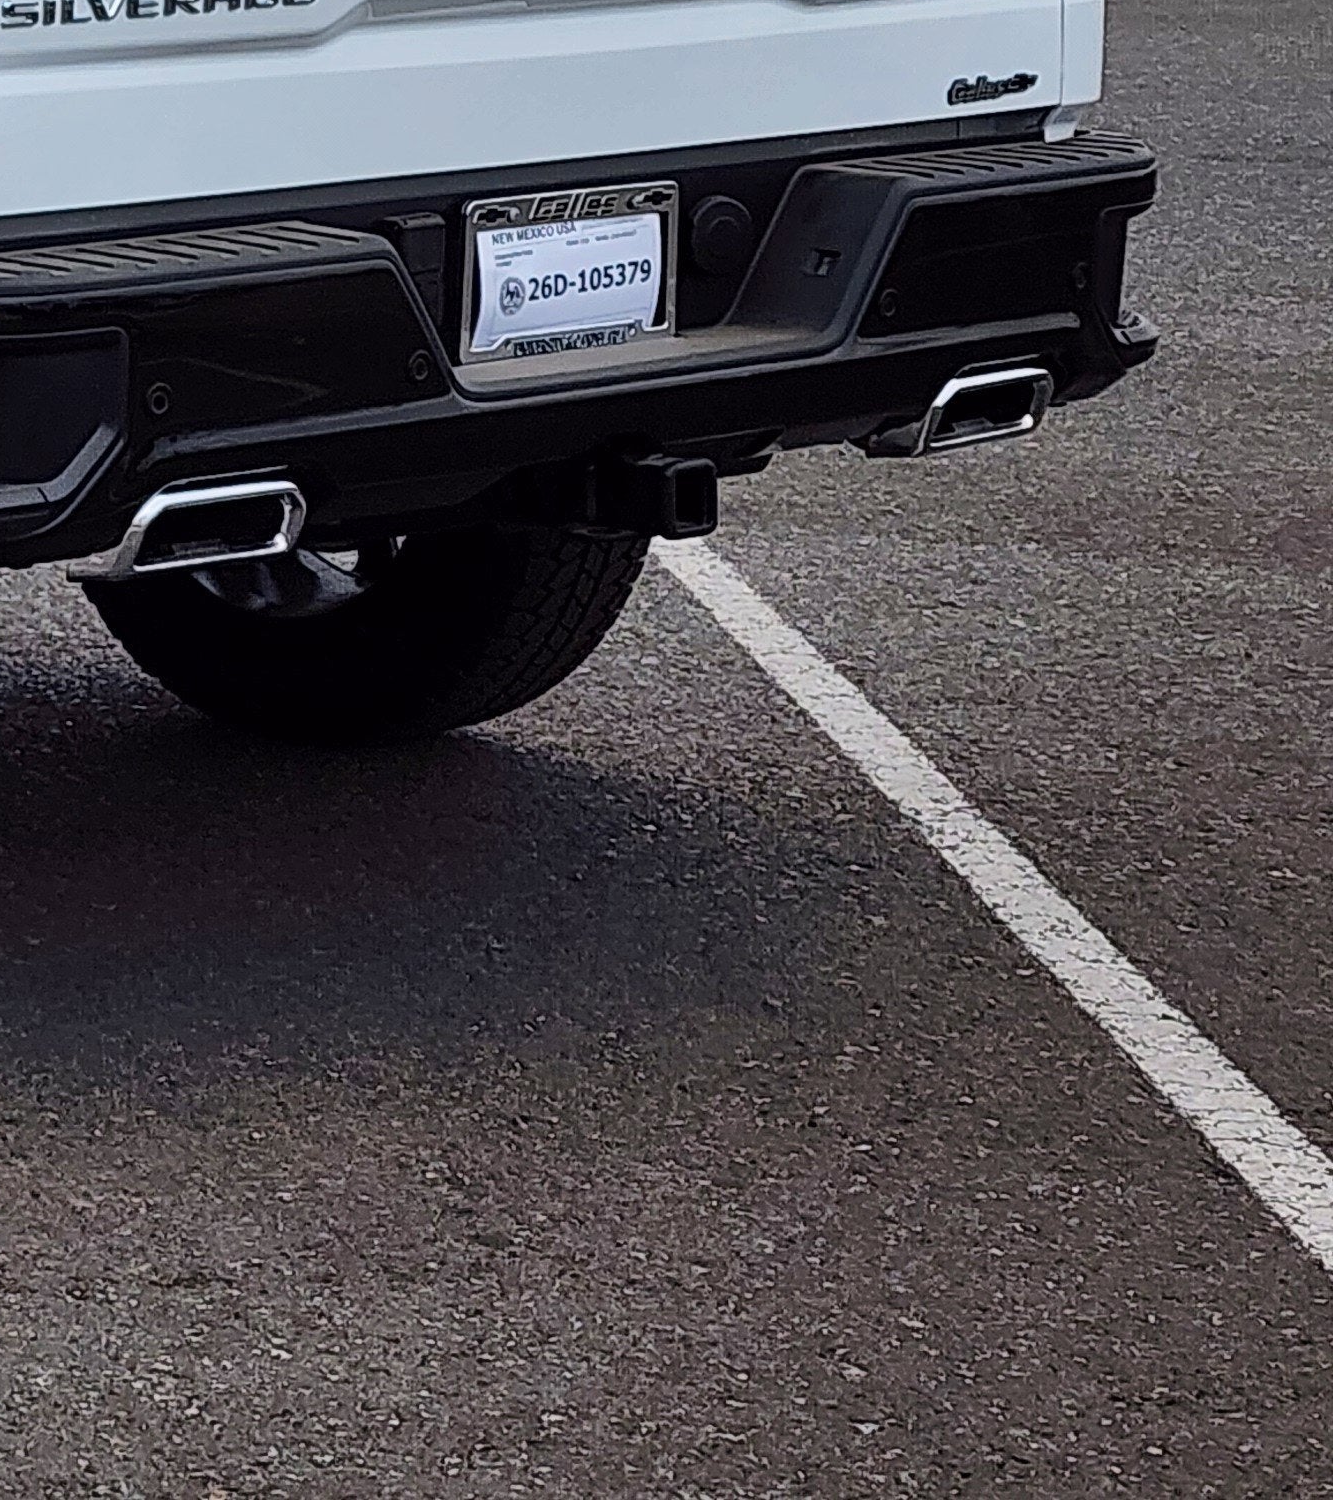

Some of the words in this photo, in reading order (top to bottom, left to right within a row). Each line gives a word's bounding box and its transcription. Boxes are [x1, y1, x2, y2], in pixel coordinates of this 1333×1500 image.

[491, 231, 514, 246] NEW
[516, 223, 554, 241] MEXICO
[556, 220, 577, 236] USA
[527, 258, 653, 302] 26D-105379
